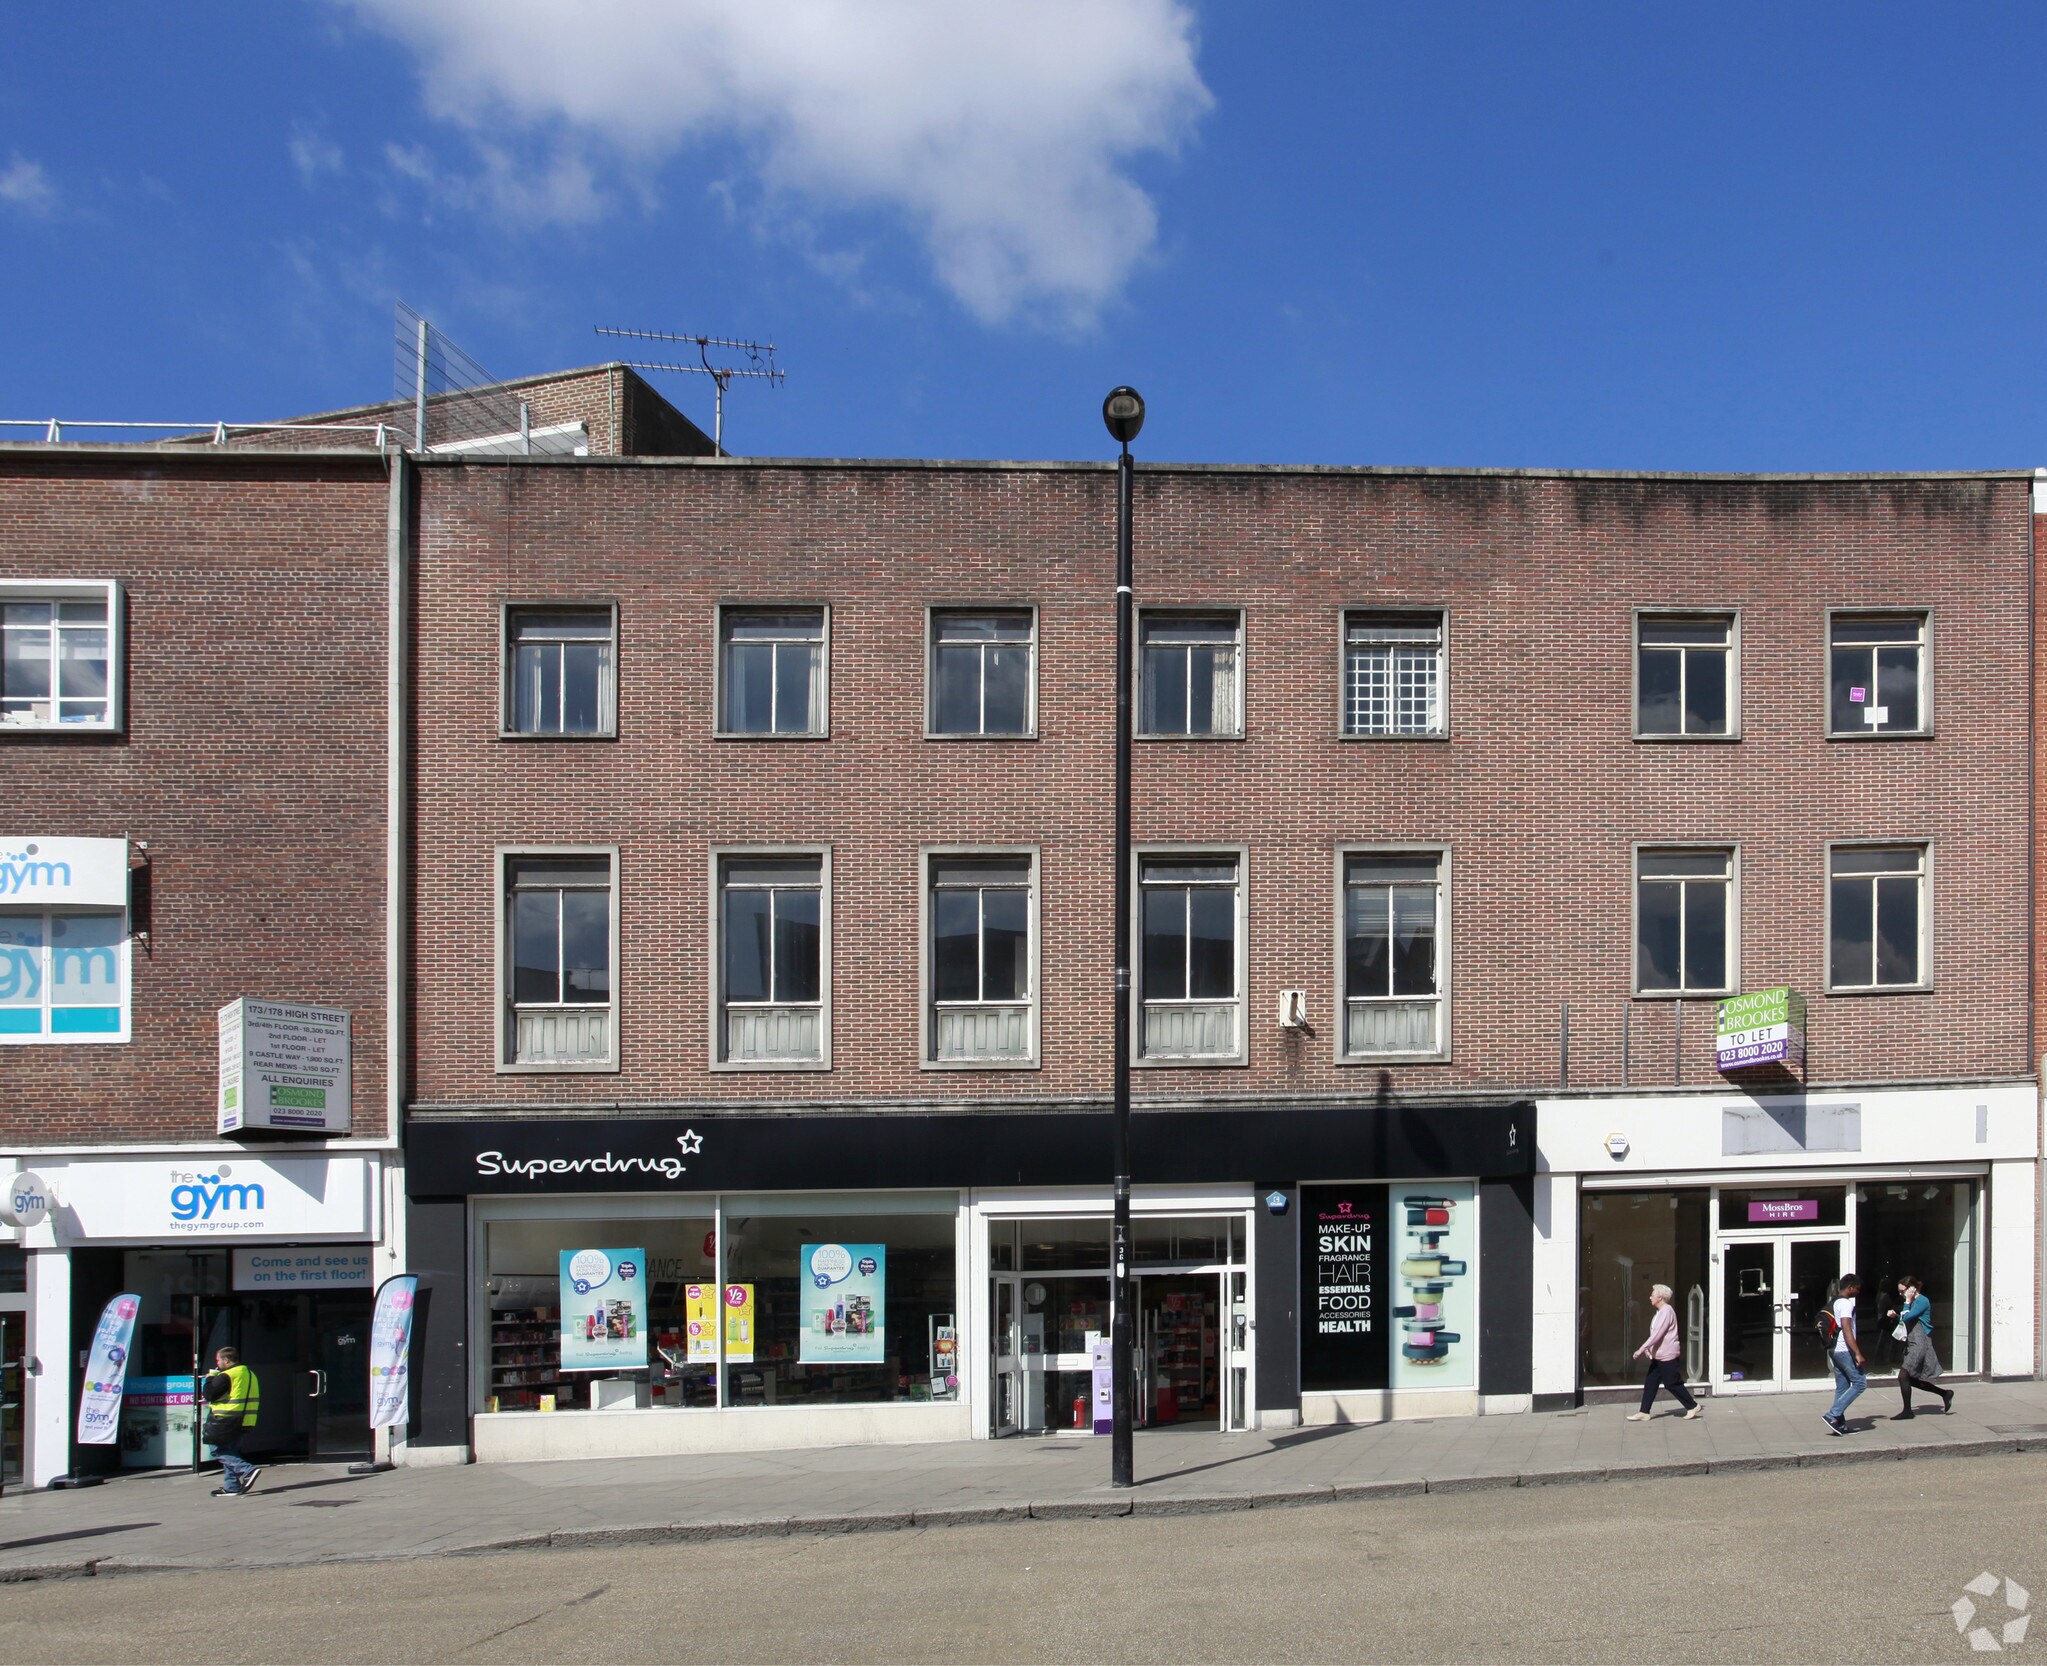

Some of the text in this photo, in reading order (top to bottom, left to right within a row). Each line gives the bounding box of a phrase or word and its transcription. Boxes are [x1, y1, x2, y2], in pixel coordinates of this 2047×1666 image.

[1726, 990, 1786, 1014] OSMOND
[248, 1005, 283, 1017] 173/178
[285, 1010, 309, 1019] HIGH
[311, 1012, 346, 1023] STREET
[1727, 1006, 1785, 1030] BROOKES
[247, 1021, 273, 1030] 3rd/4th
[274, 1023, 299, 1032] FLOOR
[268, 1032, 282, 1040] 2nd
[283, 1034, 308, 1042] FLOOR
[1730, 1028, 1773, 1046] TO LET
[281, 1044, 306, 1052] FLOOR
[1720, 1041, 1783, 1062] 023 8000 2020
[255, 1051, 284, 1060] CASTLE
[284, 1053, 301, 1061] WAY
[1720, 1052, 1783, 1069] www.osmondbrookes.co.uk
[275, 1062, 298, 1071] MEWS
[261, 1074, 334, 1087] ALL ENQUIRIES
[277, 1087, 324, 1098] OSMOND
[278, 1096, 324, 1107] BROOKES
[306, 1109, 323, 1117] 2020
[475, 1151, 687, 1180] Superdrug
[170, 1170, 194, 1184] the
[14, 1195, 46, 1213] gym
[171, 1183, 265, 1221] gym
[1762, 1202, 1803, 1212] MossBros
[1319, 1212, 1371, 1221] Superdrug
[169, 1221, 265, 1231] thegymgroup.com
[1318, 1223, 1371, 1234] MAKE-UP
[1318, 1235, 1371, 1253] SKIN
[251, 1255, 369, 1268] Come and see us
[1318, 1253, 1371, 1262] FRAGRANCE
[253, 1268, 366, 1282] on the first floor!
[1318, 1263, 1371, 1284] HAIR
[1318, 1285, 1371, 1295] ESSENTIALS
[1318, 1295, 1371, 1311] FOOD
[1319, 1311, 1371, 1319] ACCESSORIES
[1318, 1320, 1371, 1334] HEALTH
